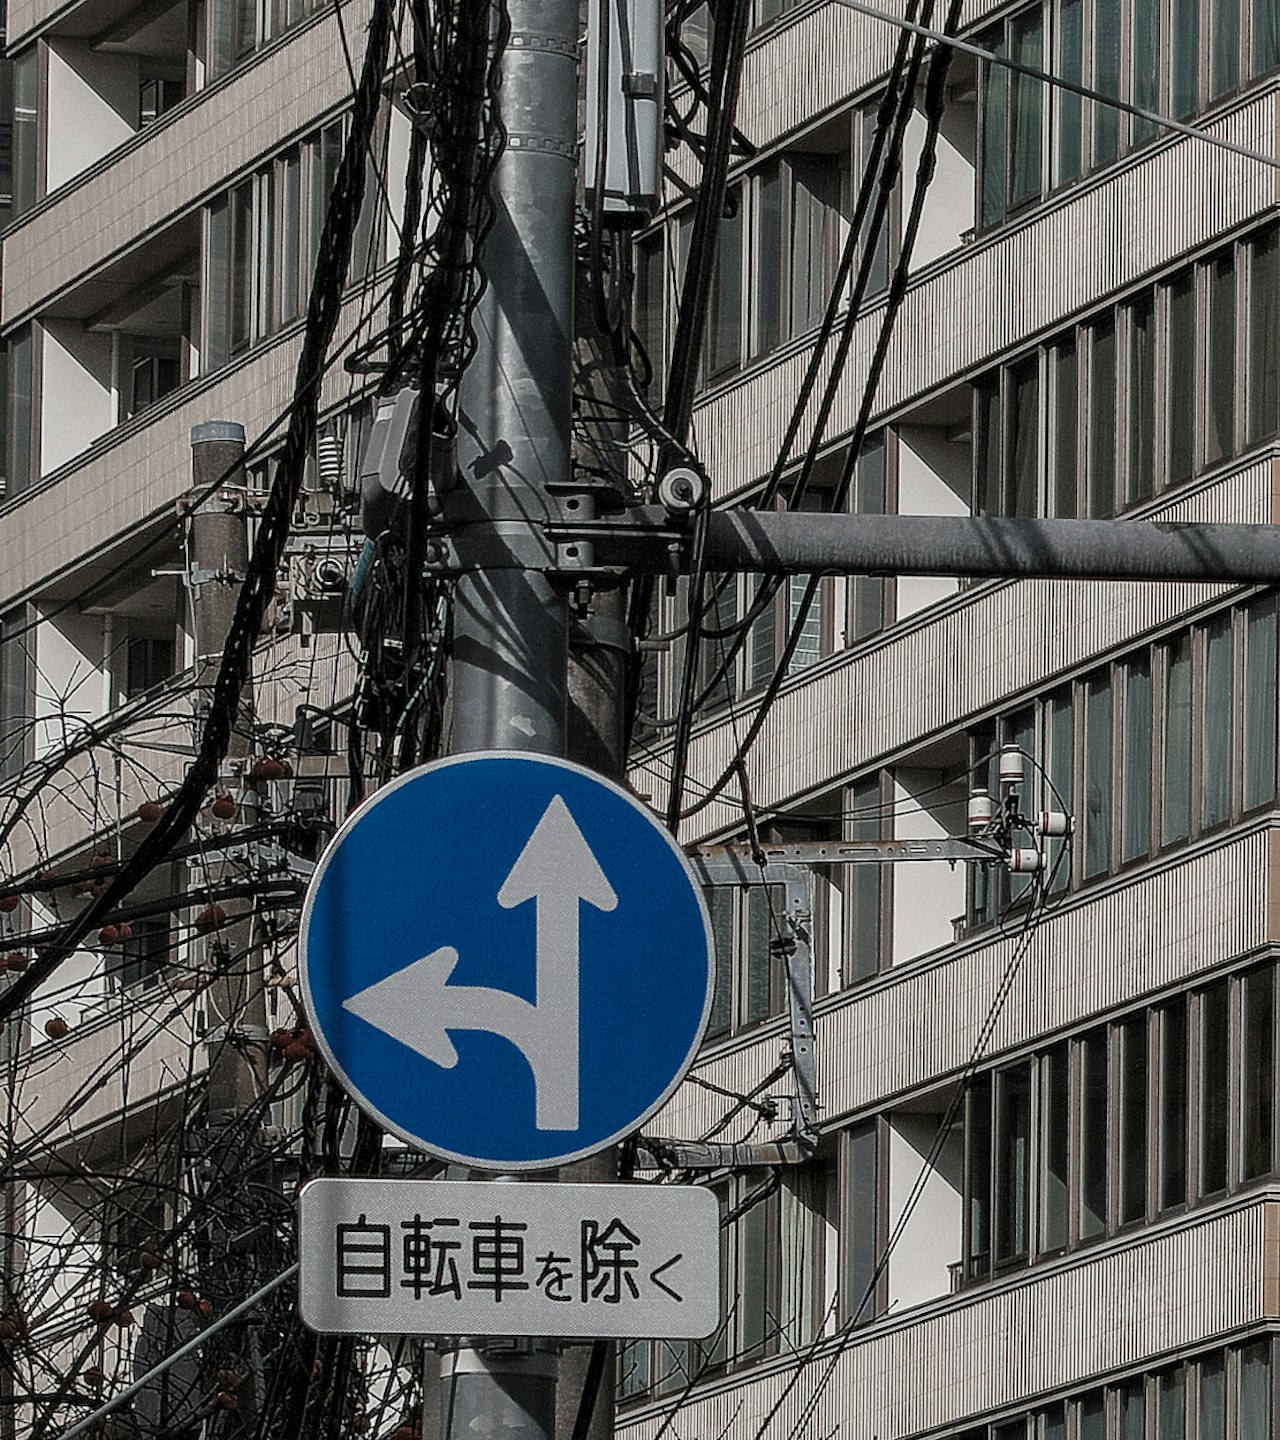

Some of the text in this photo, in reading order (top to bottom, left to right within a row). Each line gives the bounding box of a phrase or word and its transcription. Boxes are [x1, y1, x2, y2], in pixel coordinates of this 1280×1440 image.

[336, 1214, 683, 1303] 自転車を除く
